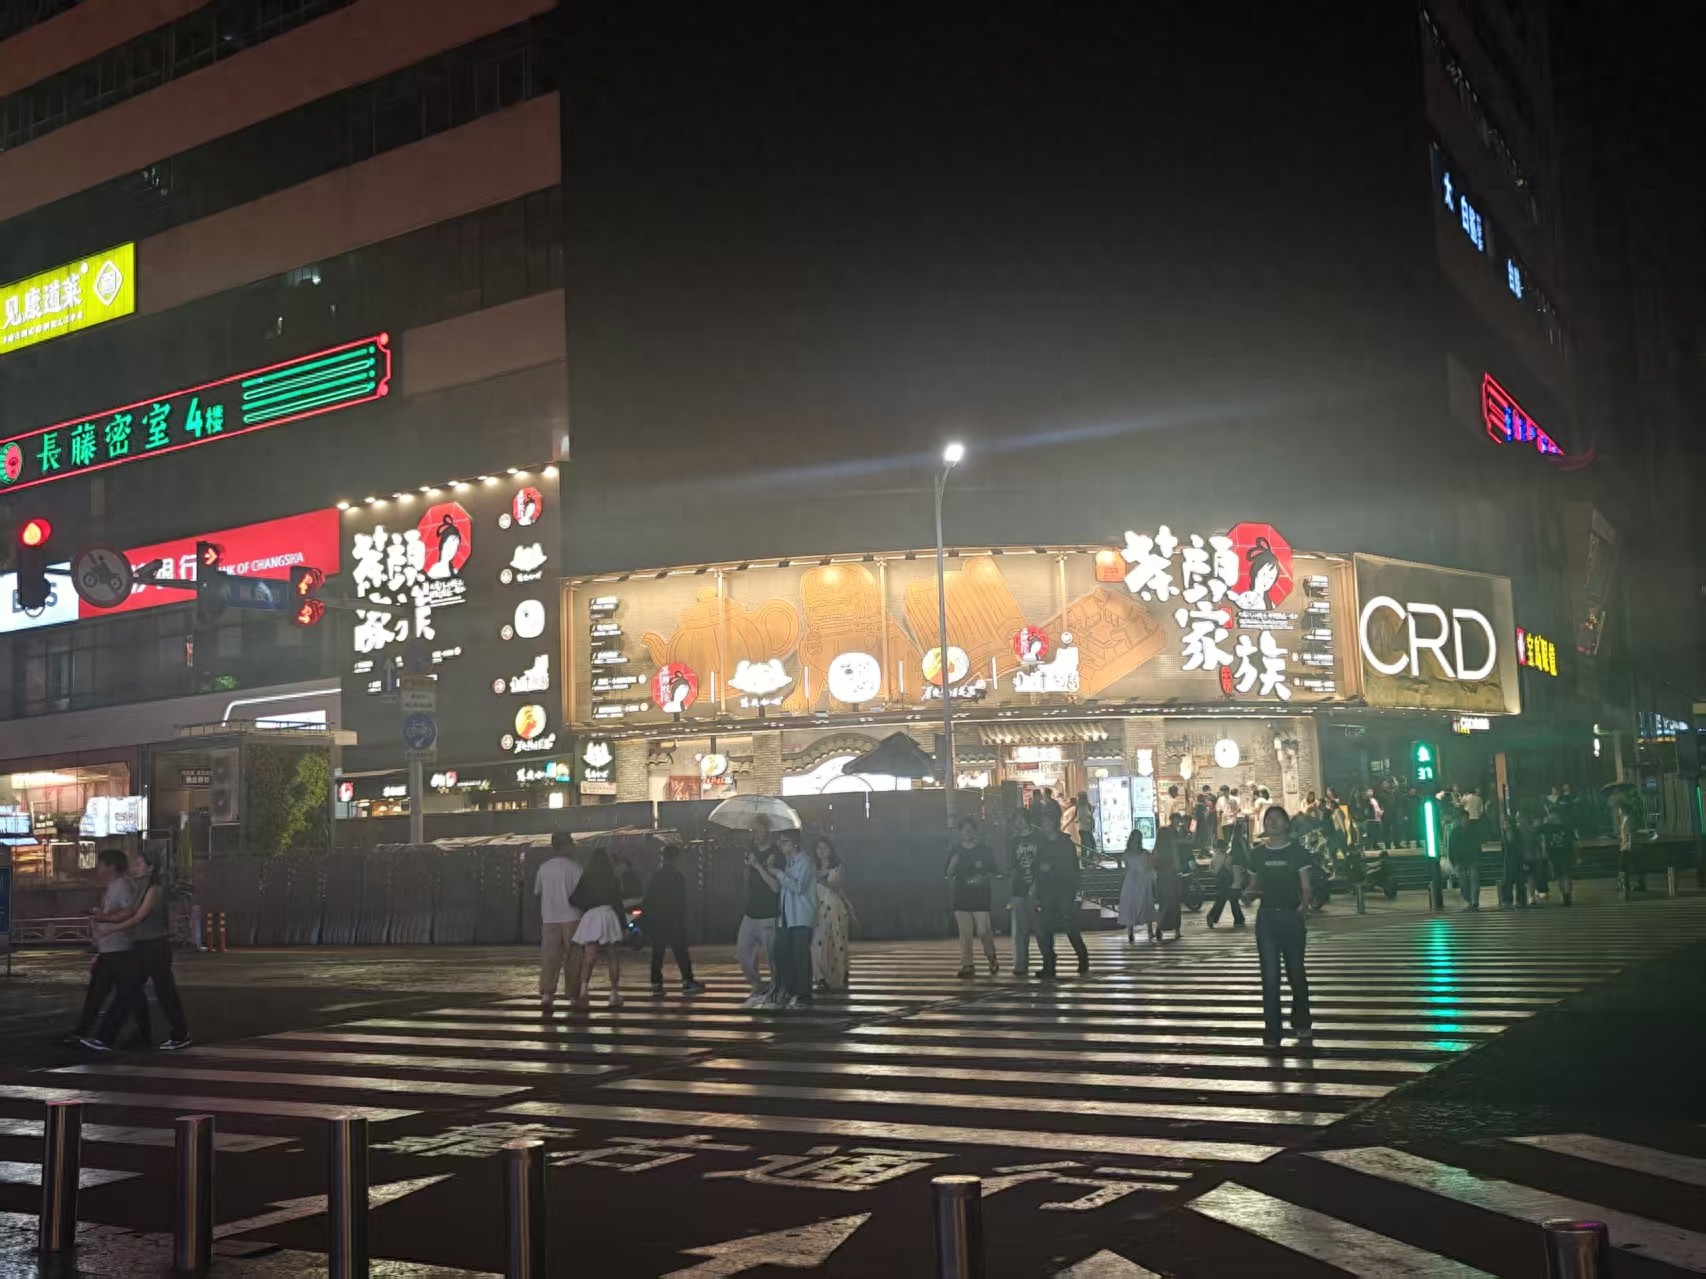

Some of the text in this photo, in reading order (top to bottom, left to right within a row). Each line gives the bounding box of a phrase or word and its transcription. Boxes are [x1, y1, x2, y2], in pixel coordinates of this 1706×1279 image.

[237, 561, 250, 575] OF
[251, 551, 304, 572] CHANGSHA
[1359, 595, 1497, 680] CRD
